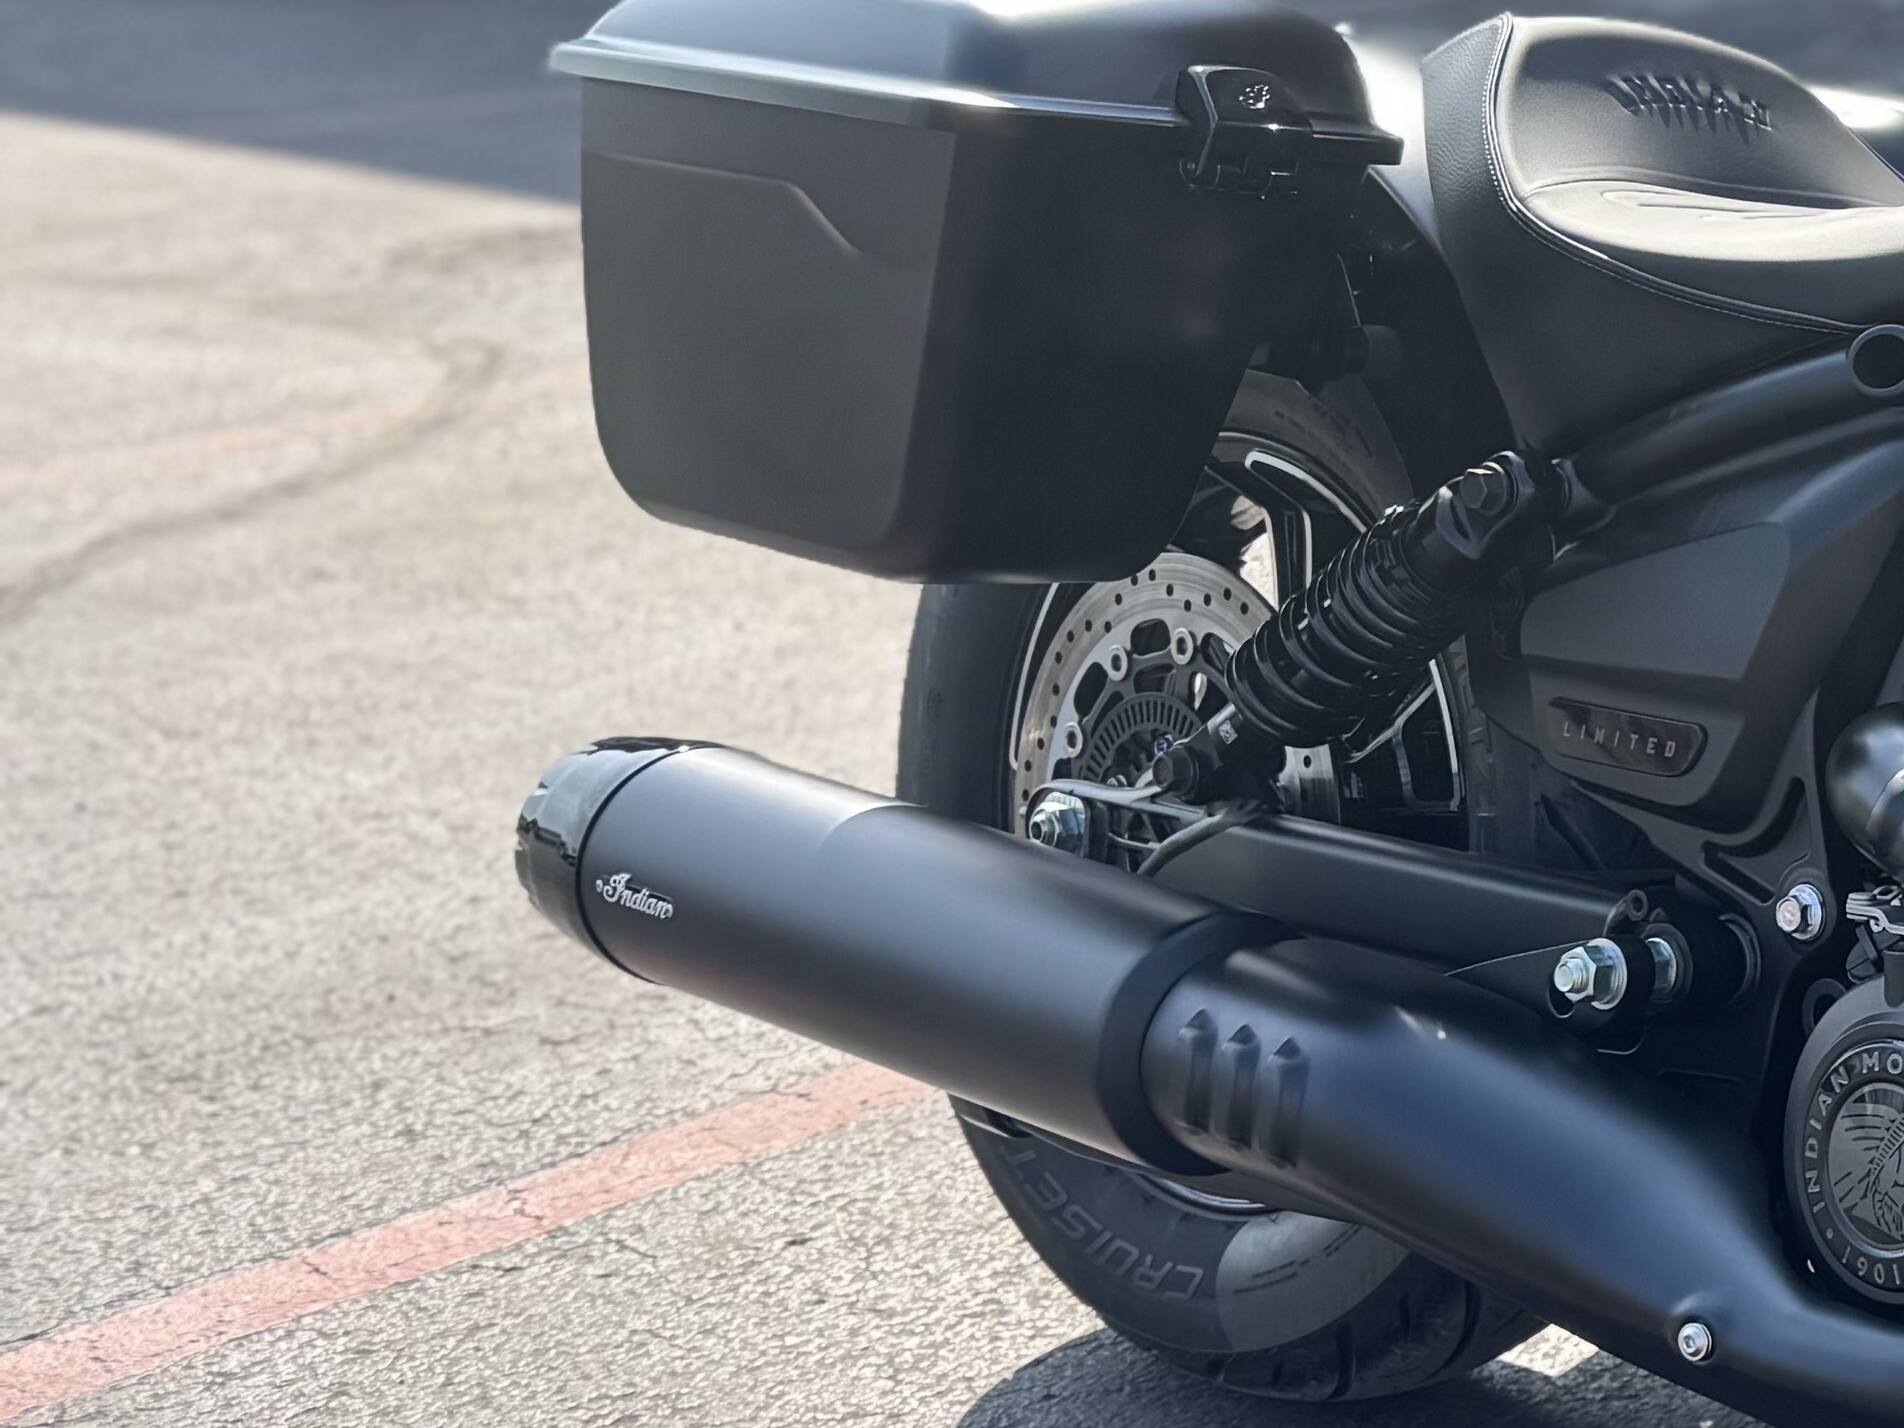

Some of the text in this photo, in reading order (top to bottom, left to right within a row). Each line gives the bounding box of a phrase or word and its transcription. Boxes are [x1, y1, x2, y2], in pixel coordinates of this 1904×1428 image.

[1563, 720, 1677, 759] LIMITED
[603, 873, 668, 919] Indian
[1804, 1065, 1852, 1213] INDIAN
[1841, 1245, 1902, 1286] 1901
